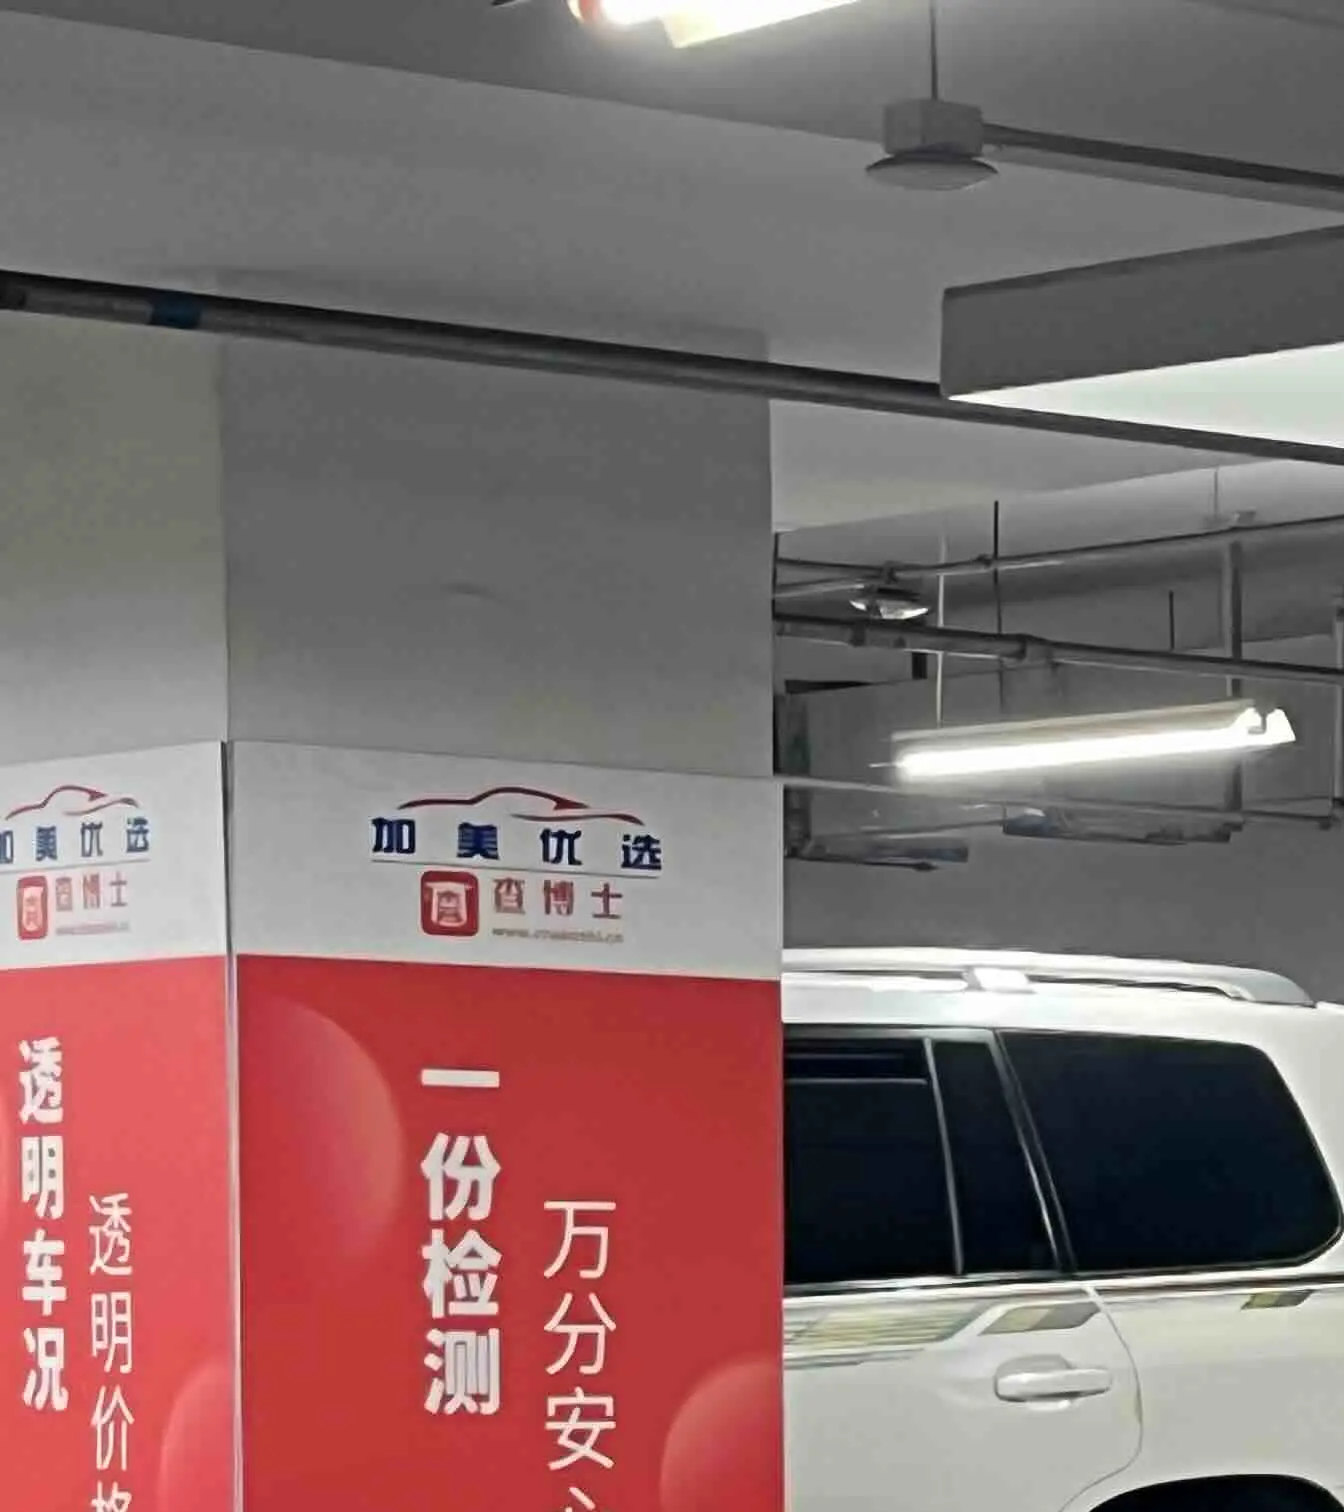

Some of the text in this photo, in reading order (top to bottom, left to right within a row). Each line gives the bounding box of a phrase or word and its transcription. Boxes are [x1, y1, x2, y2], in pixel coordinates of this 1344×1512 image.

[371, 817, 662, 870] 加美优选
[493, 876, 624, 919] 查博士
[18, 1036, 69, 1411] 透明车况
[420, 1069, 502, 1415] 一份检测
